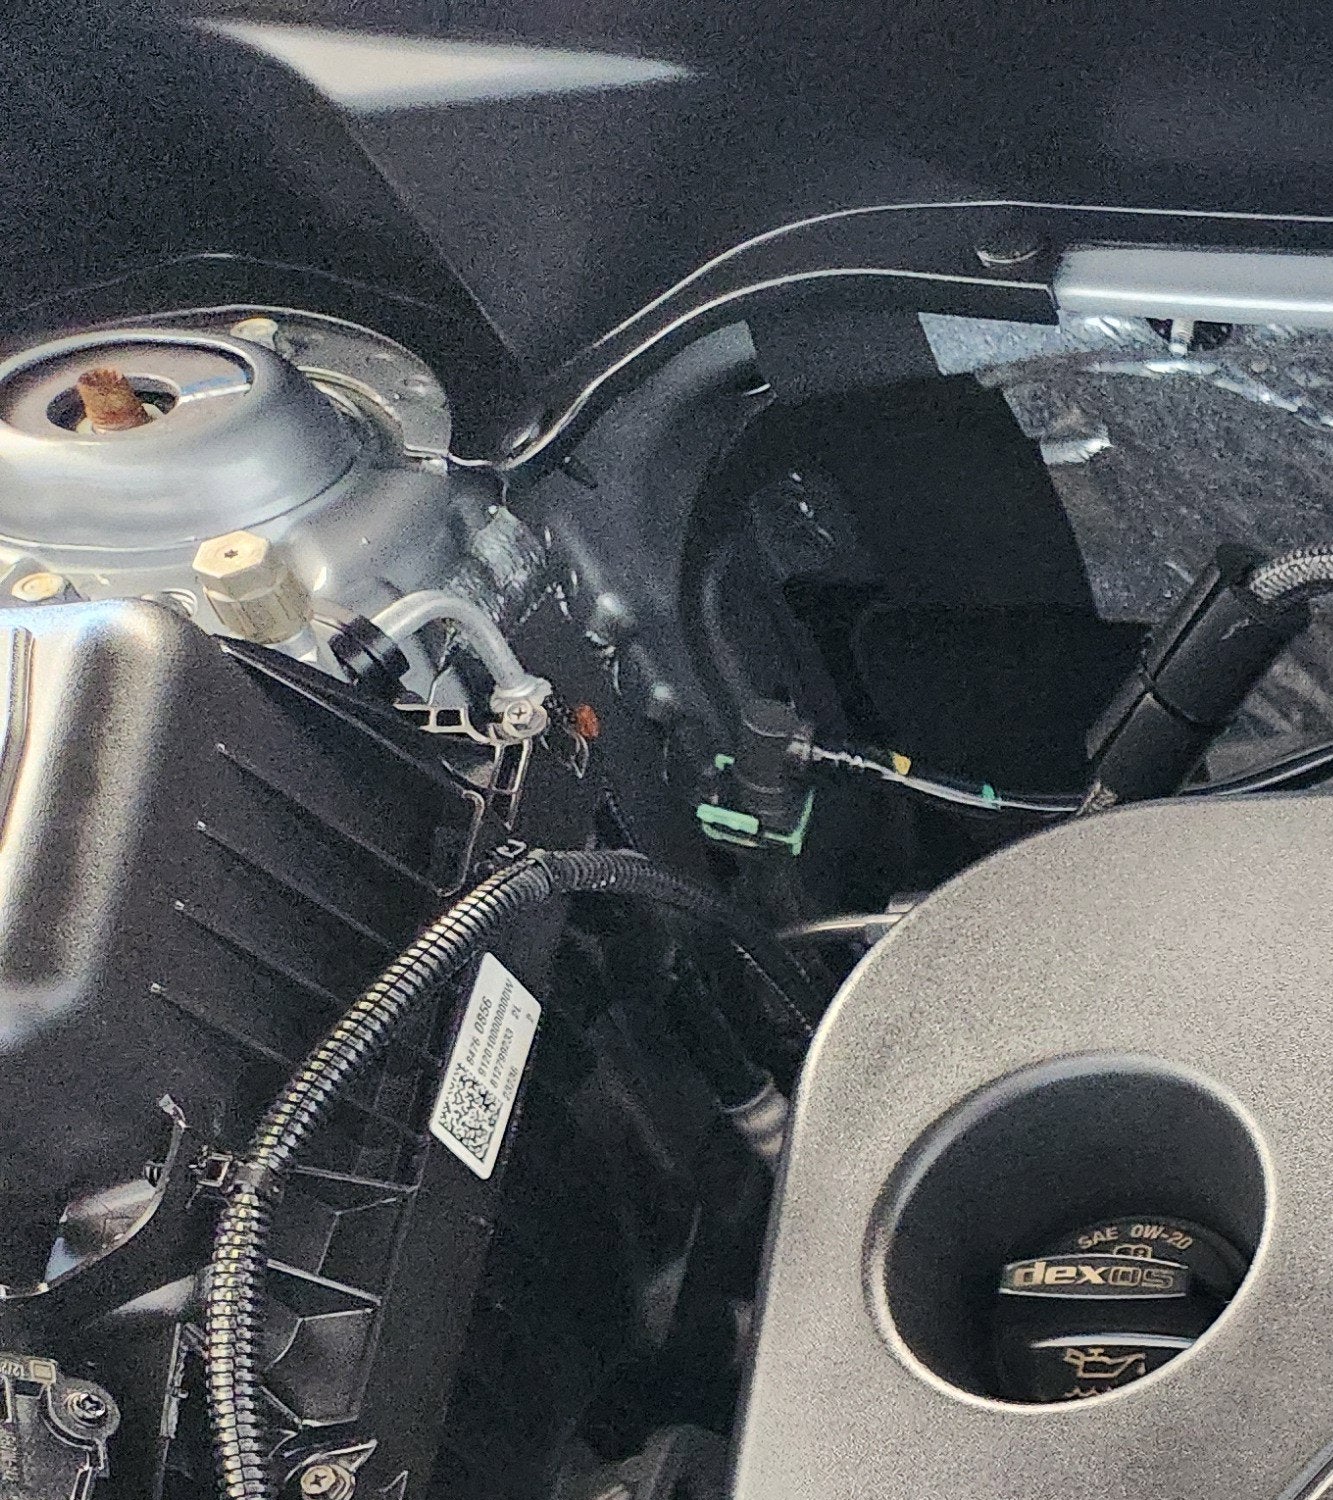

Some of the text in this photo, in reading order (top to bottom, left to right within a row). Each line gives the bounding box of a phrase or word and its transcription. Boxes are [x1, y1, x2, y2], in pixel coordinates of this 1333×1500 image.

[474, 995, 493, 1034] 0856
[1077, 1223, 1194, 1251] SAE 0W-20
[1012, 1261, 1176, 1289] dexos
